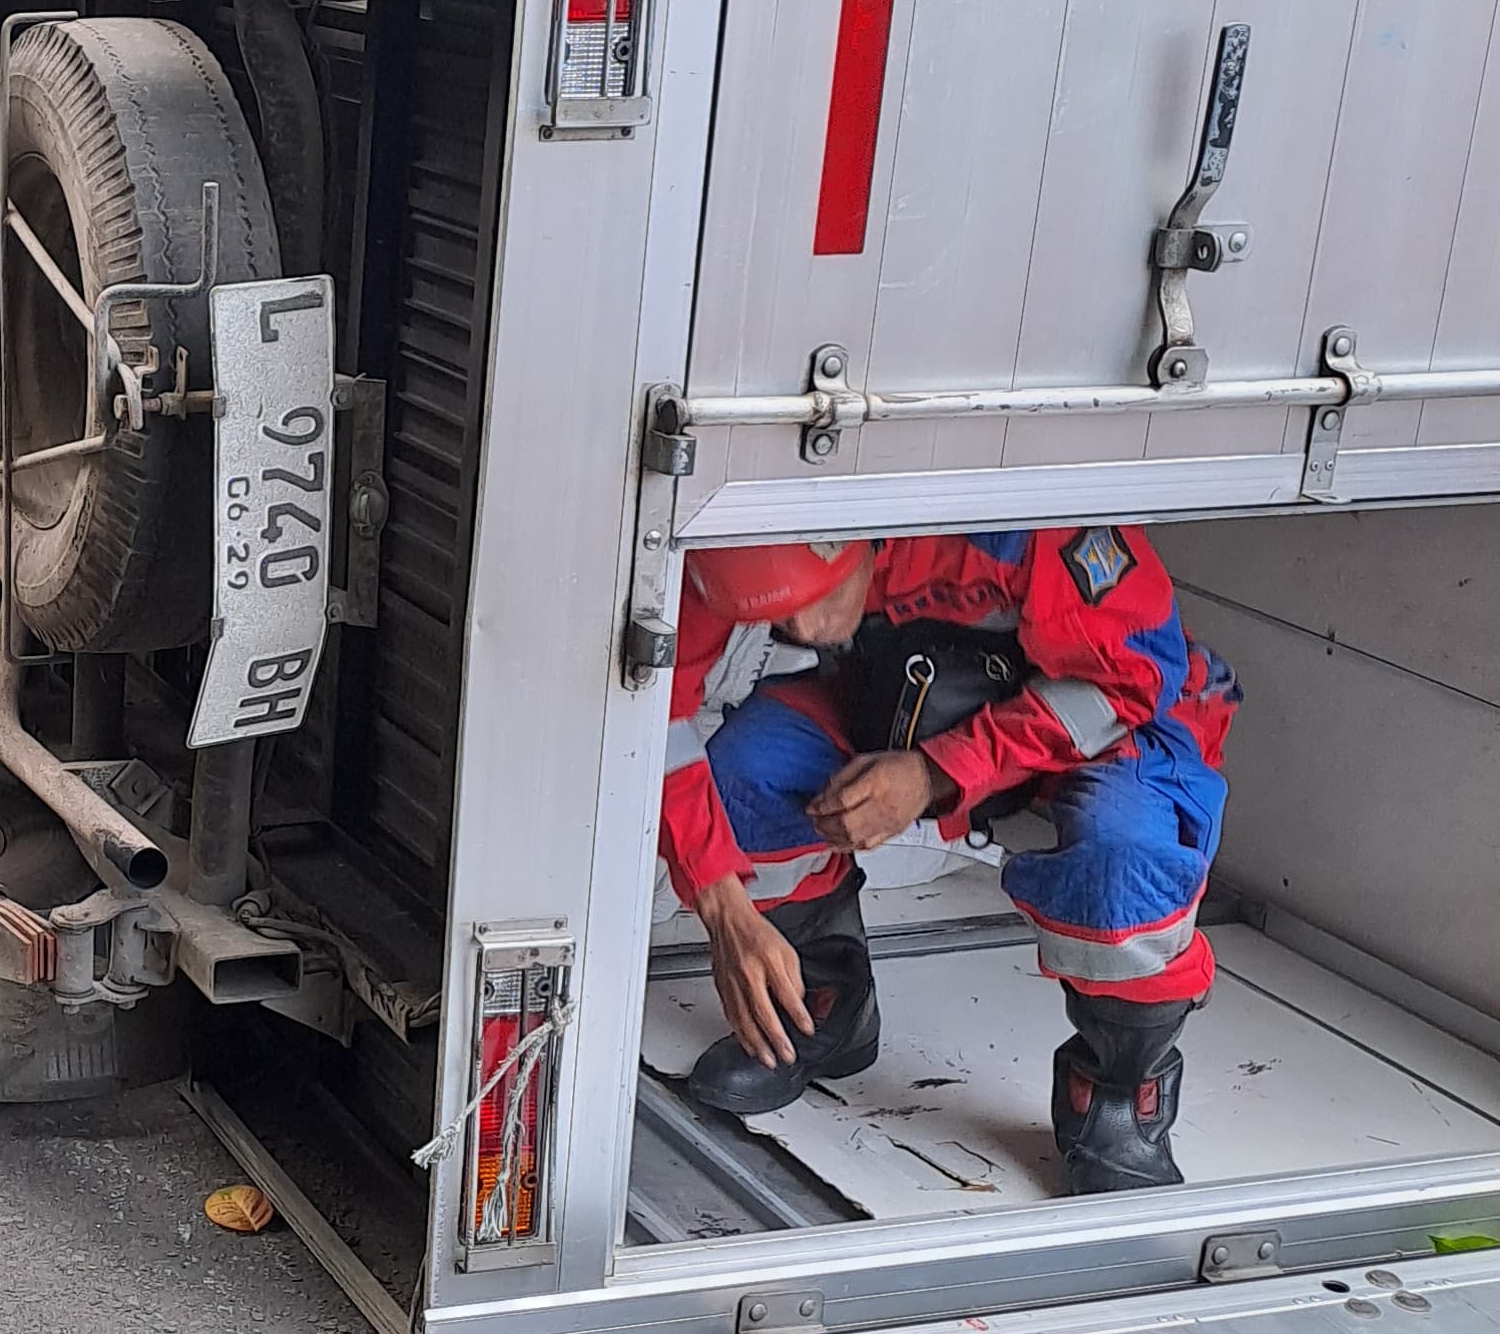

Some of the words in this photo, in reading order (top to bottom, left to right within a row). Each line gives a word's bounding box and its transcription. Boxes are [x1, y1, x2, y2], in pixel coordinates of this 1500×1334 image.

[259, 292, 324, 344] L
[259, 405, 326, 589] 9740
[233, 647, 313, 729] BH
